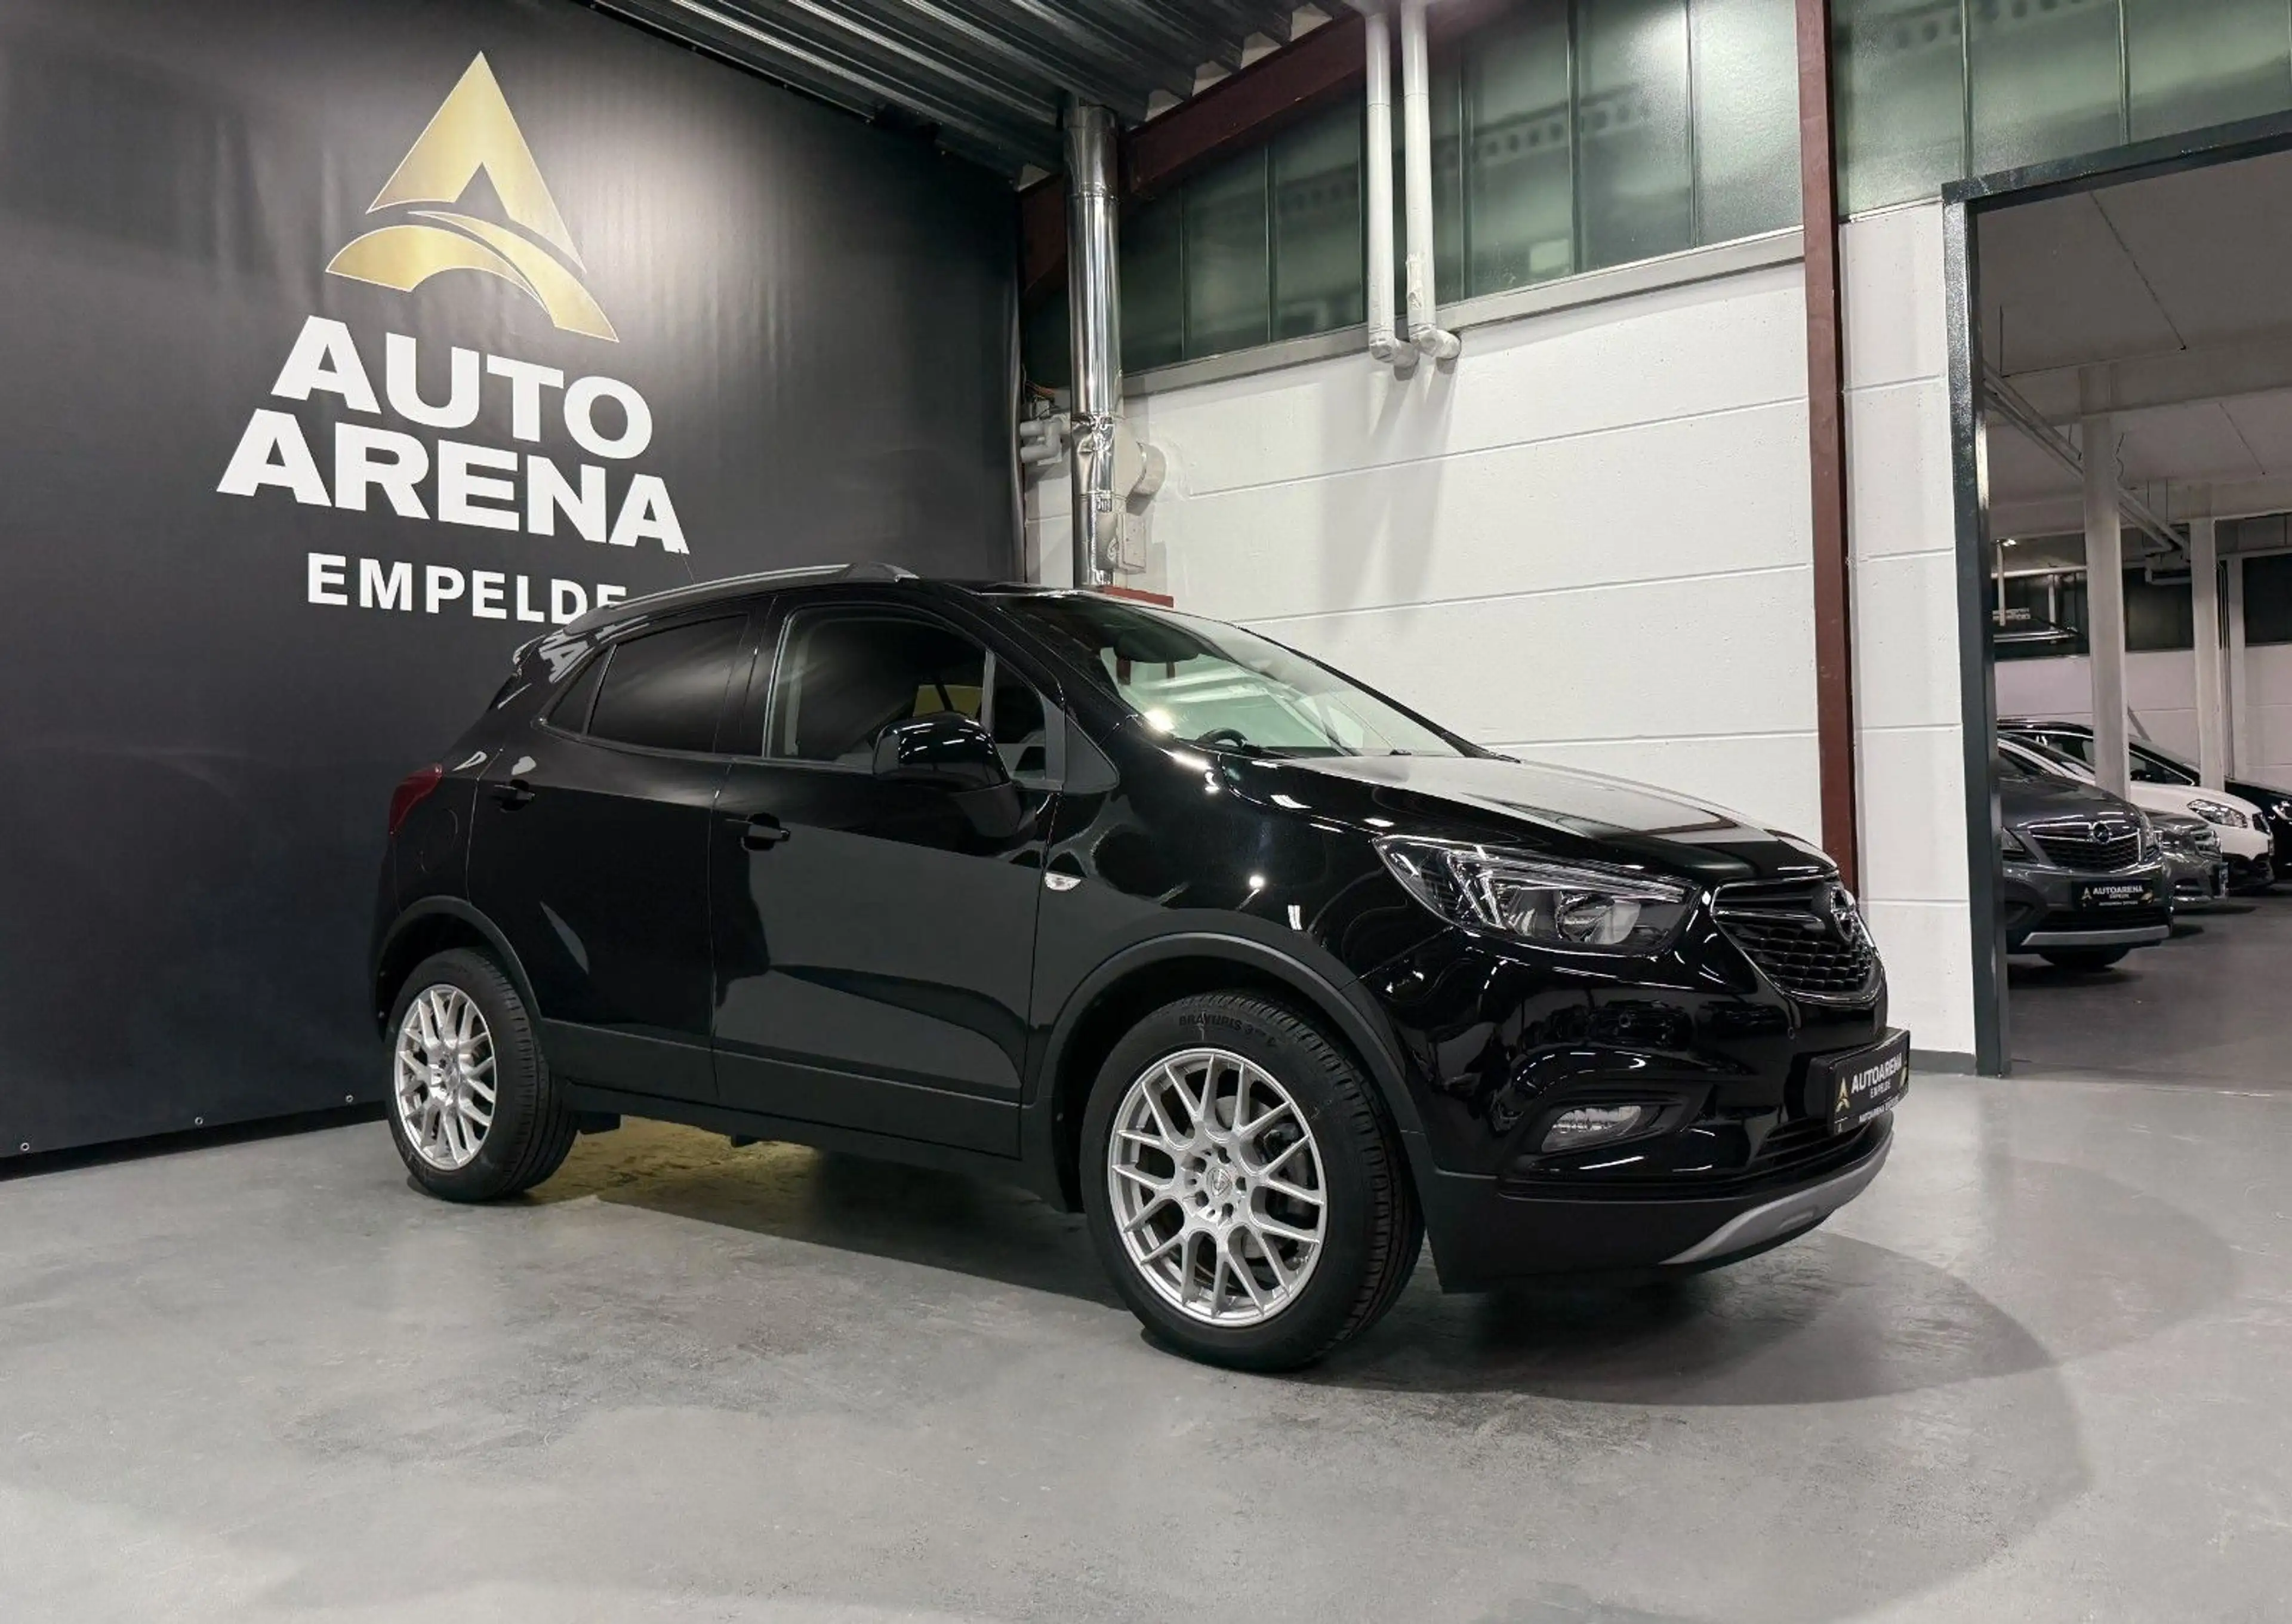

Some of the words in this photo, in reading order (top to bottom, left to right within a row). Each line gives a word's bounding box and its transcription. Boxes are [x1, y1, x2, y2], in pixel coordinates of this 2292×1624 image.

[270, 315, 653, 460] AUTO
[216, 409, 690, 555] ARENA
[2093, 885, 2144, 895] AUTOARENA
[1851, 1052, 1902, 1094] AUTOARENA
